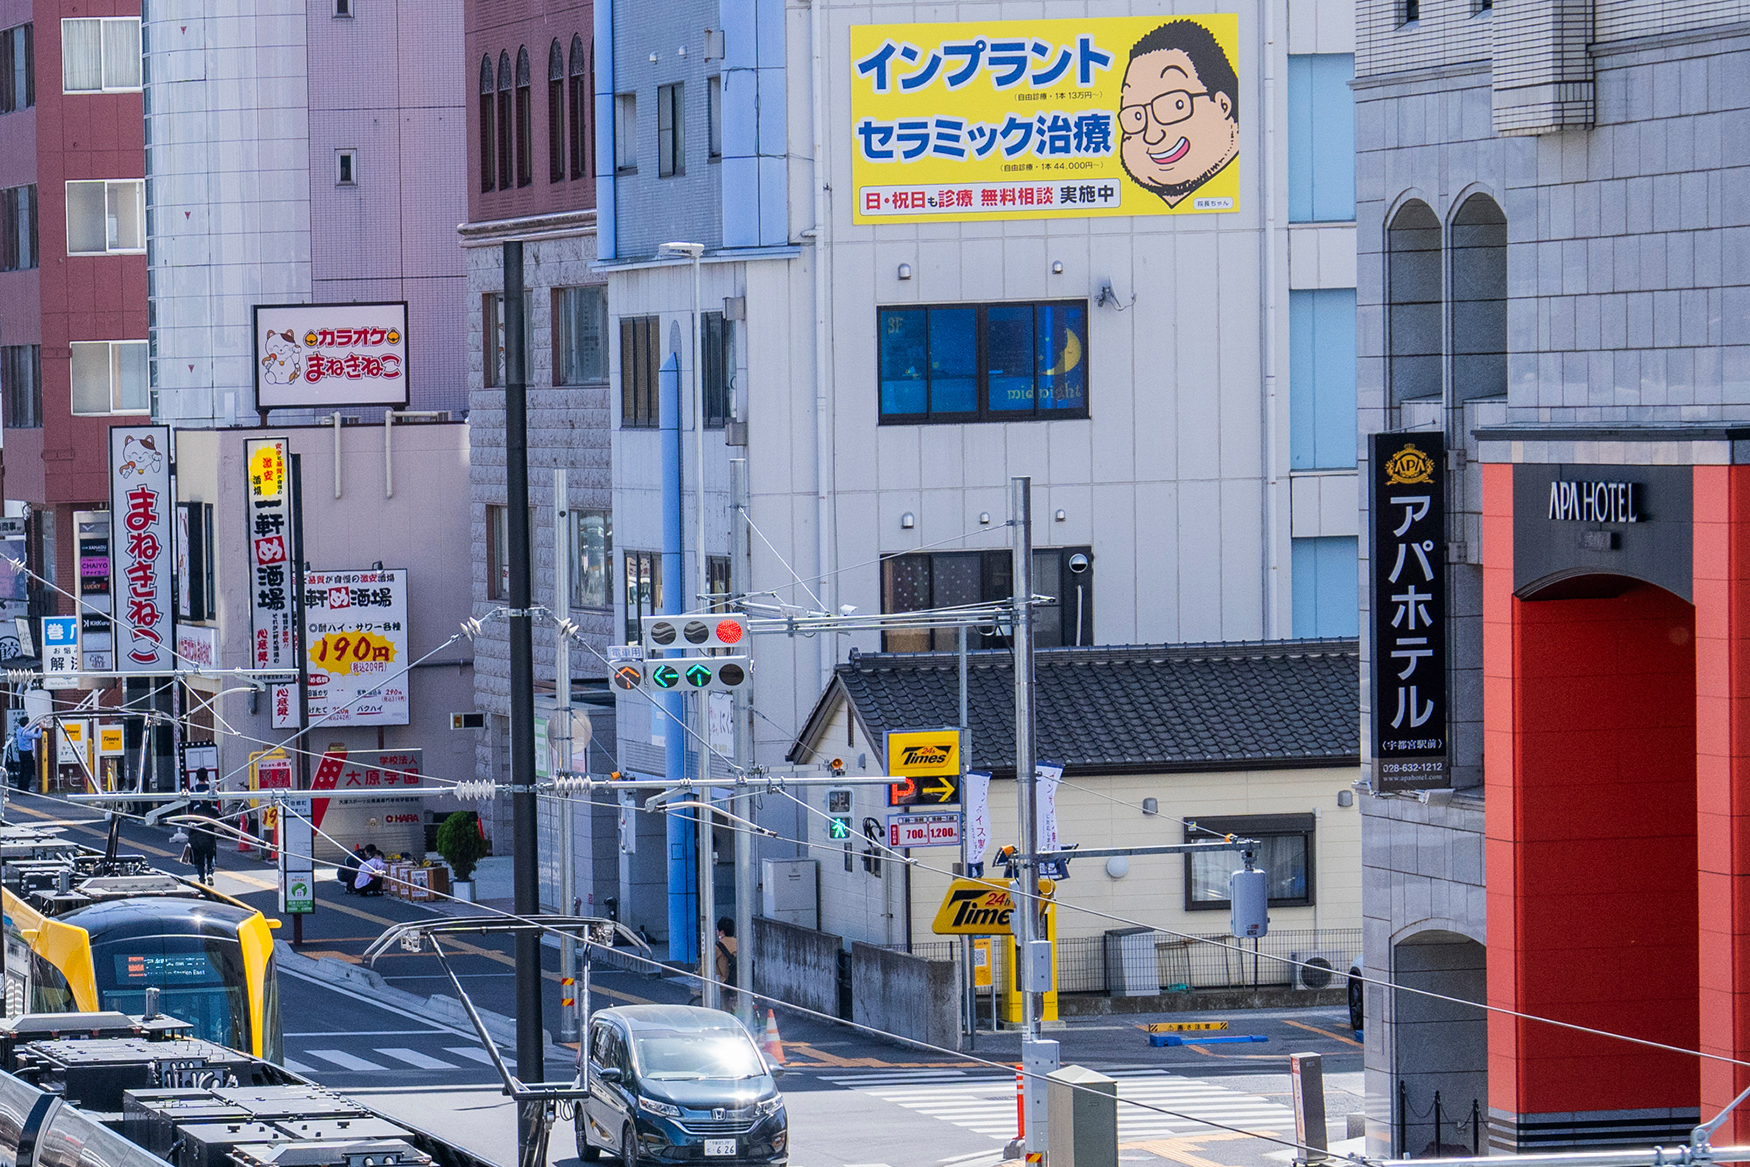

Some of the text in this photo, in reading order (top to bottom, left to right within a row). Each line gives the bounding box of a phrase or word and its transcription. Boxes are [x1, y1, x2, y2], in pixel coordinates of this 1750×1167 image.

[858, 38, 1111, 90] インプラント
[858, 114, 1112, 160] セラミック治療
[866, 184, 1115, 211] 日・祝日も診療 無料相談 実施中
[318, 328, 387, 346] カラオケ
[305, 352, 401, 382] まねきねこ
[262, 457, 273, 482] 激安
[1394, 459, 1426, 472] APA
[252, 475, 262, 496] 酒場
[1548, 481, 1638, 523] APA HOTEL
[81, 562, 108, 570] CHAIYO
[253, 499, 286, 611] 一軒め酒場
[126, 485, 161, 662] まねきねこ
[1388, 495, 1435, 730] アパホテル
[318, 635, 390, 663] 190円
[379, 755, 418, 766] 学校法人
[901, 745, 952, 766] Times
[1382, 762, 1443, 773] 028-632-1212
[345, 768, 420, 787] 大原学園
[946, 889, 1015, 928] Time
